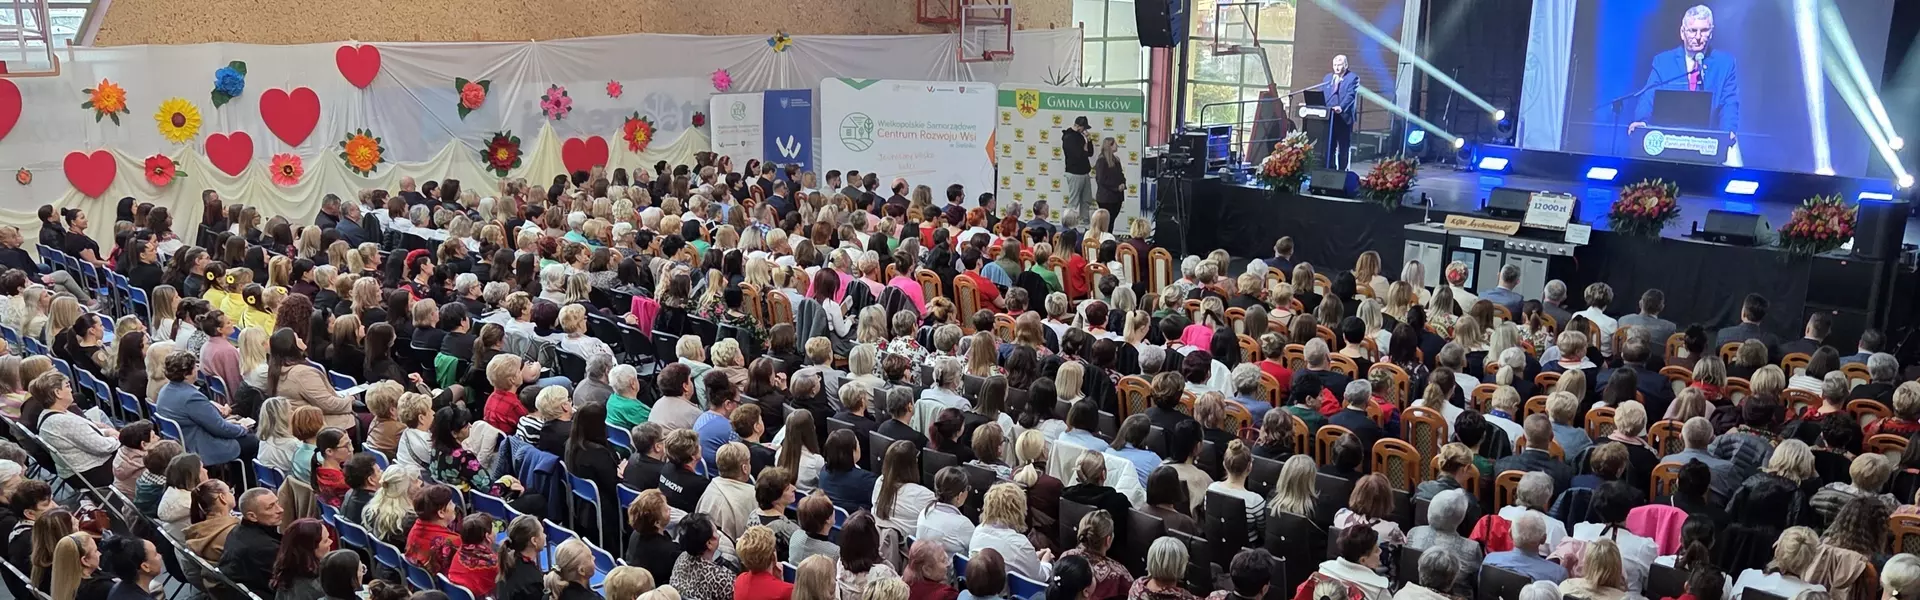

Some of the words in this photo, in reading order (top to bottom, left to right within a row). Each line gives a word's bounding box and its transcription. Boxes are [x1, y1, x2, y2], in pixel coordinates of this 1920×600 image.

[1047, 95, 1085, 109] GMINA
[1089, 96, 1131, 110] LISKÓW
[877, 119, 925, 130] Wielkopolskie
[926, 121, 977, 131] Samorządowe
[877, 128, 917, 139] Centrum
[920, 130, 957, 142] Rozwoju
[960, 132, 977, 142] Wsi
